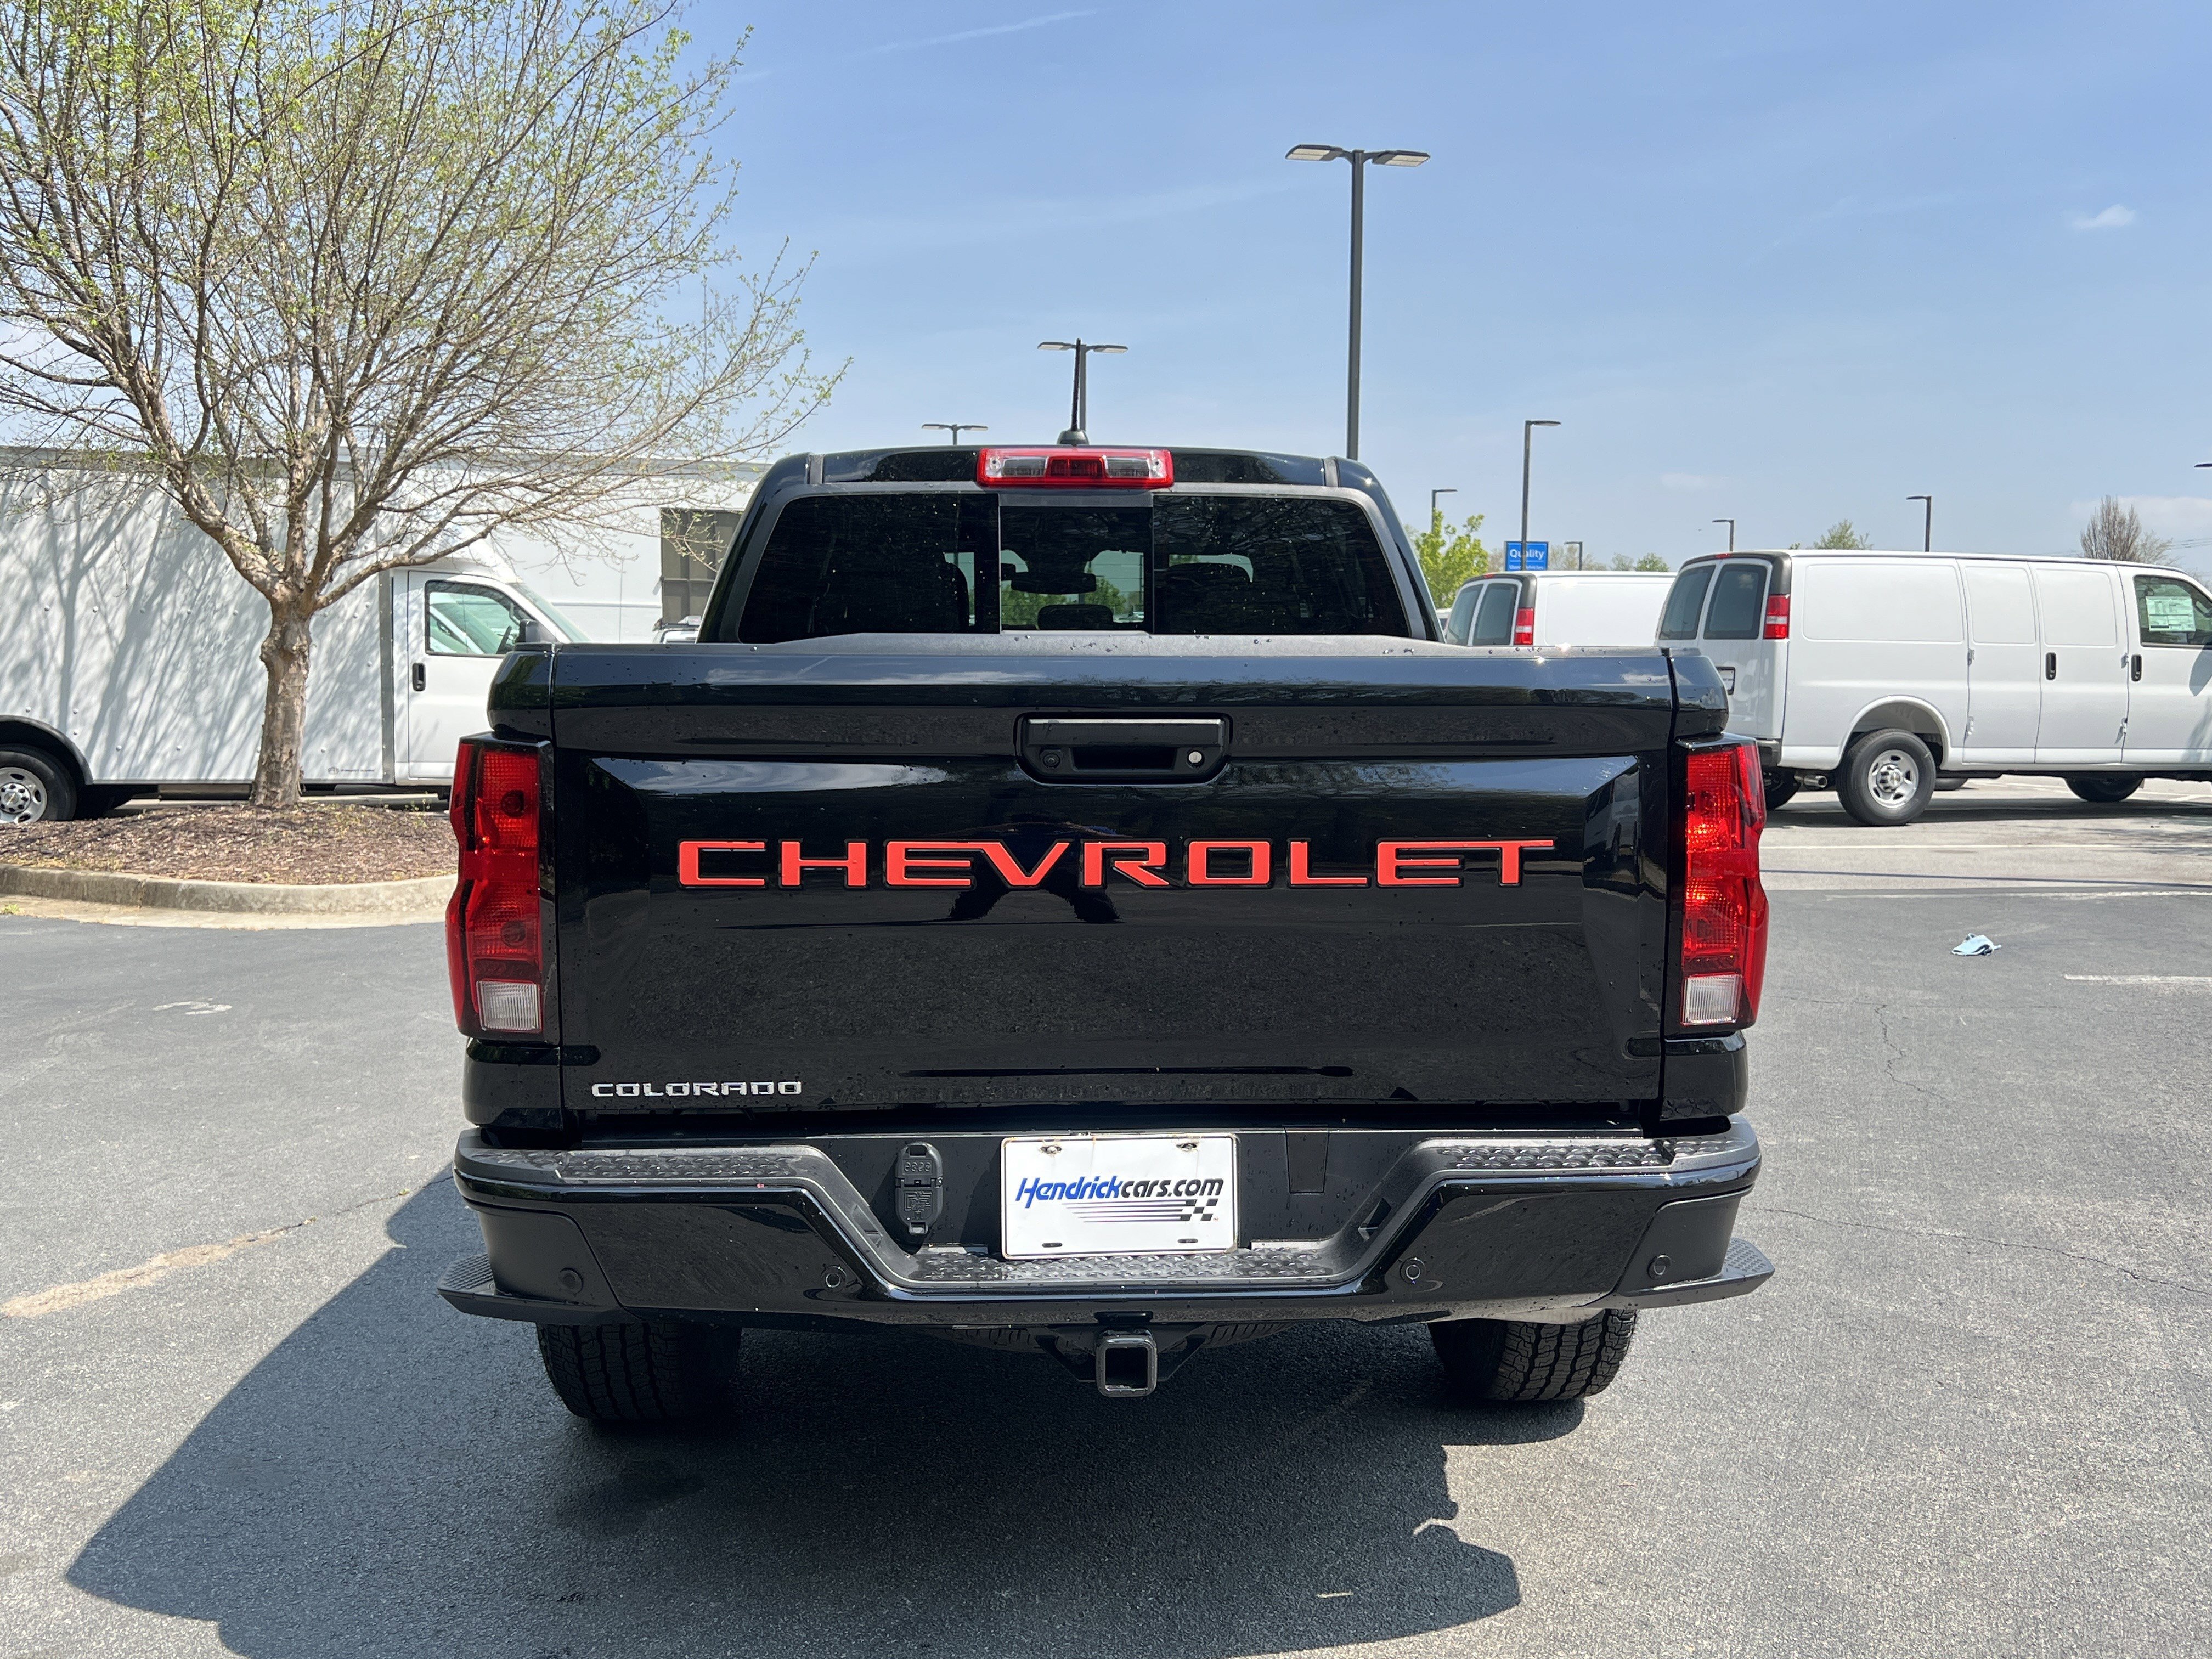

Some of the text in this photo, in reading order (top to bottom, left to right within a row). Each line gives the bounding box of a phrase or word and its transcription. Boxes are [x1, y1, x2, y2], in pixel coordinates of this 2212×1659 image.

[679, 839, 1554, 886] CHEVROLET
[591, 1081, 802, 1097] COLORADO
[1015, 1176, 1224, 1209] Hendrickcars.com
